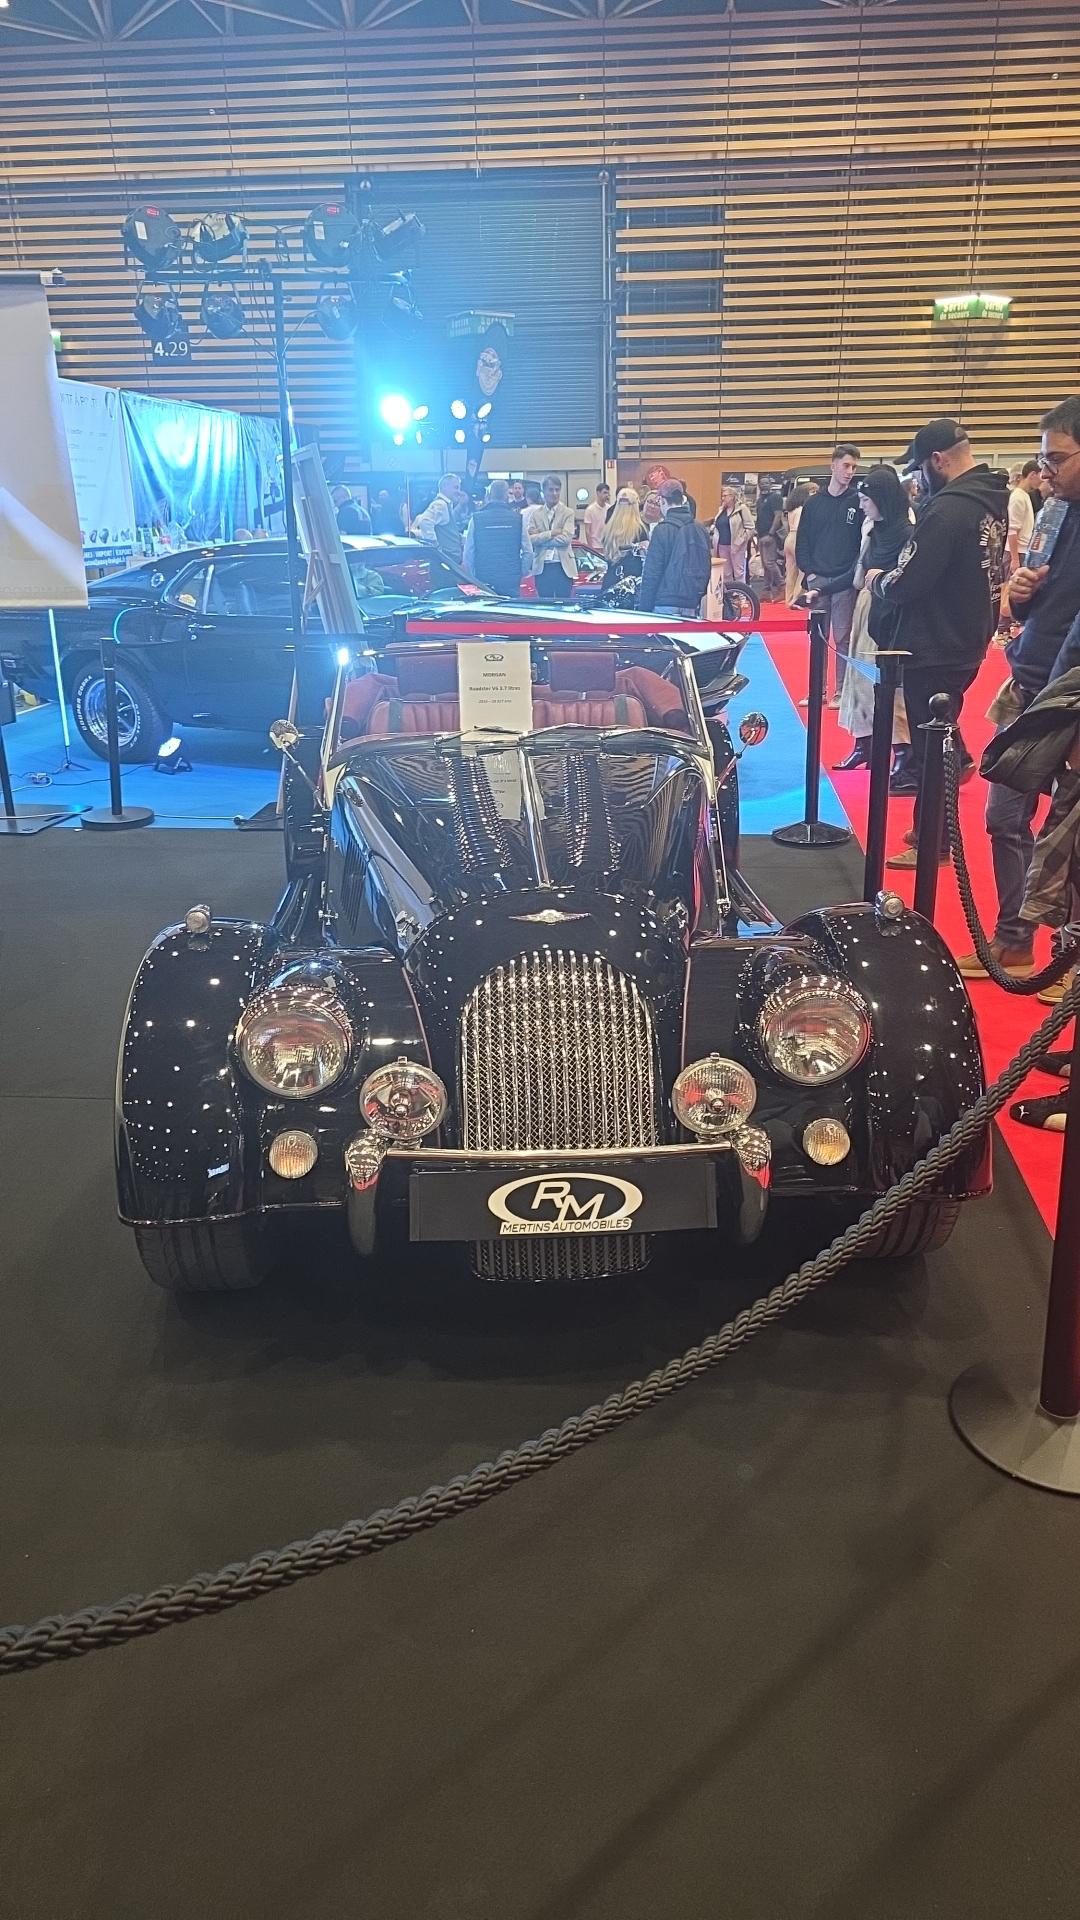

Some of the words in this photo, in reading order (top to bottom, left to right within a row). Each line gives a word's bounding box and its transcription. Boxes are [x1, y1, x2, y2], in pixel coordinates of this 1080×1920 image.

[948, 310, 970, 320] secours
[154, 341, 188, 357] 4.29
[77, 674, 93, 697] COBRA
[531, 1181, 605, 1221] RM
[502, 1222, 551, 1233] MERTINS
[552, 1218, 631, 1232] AUTOMOBILES
